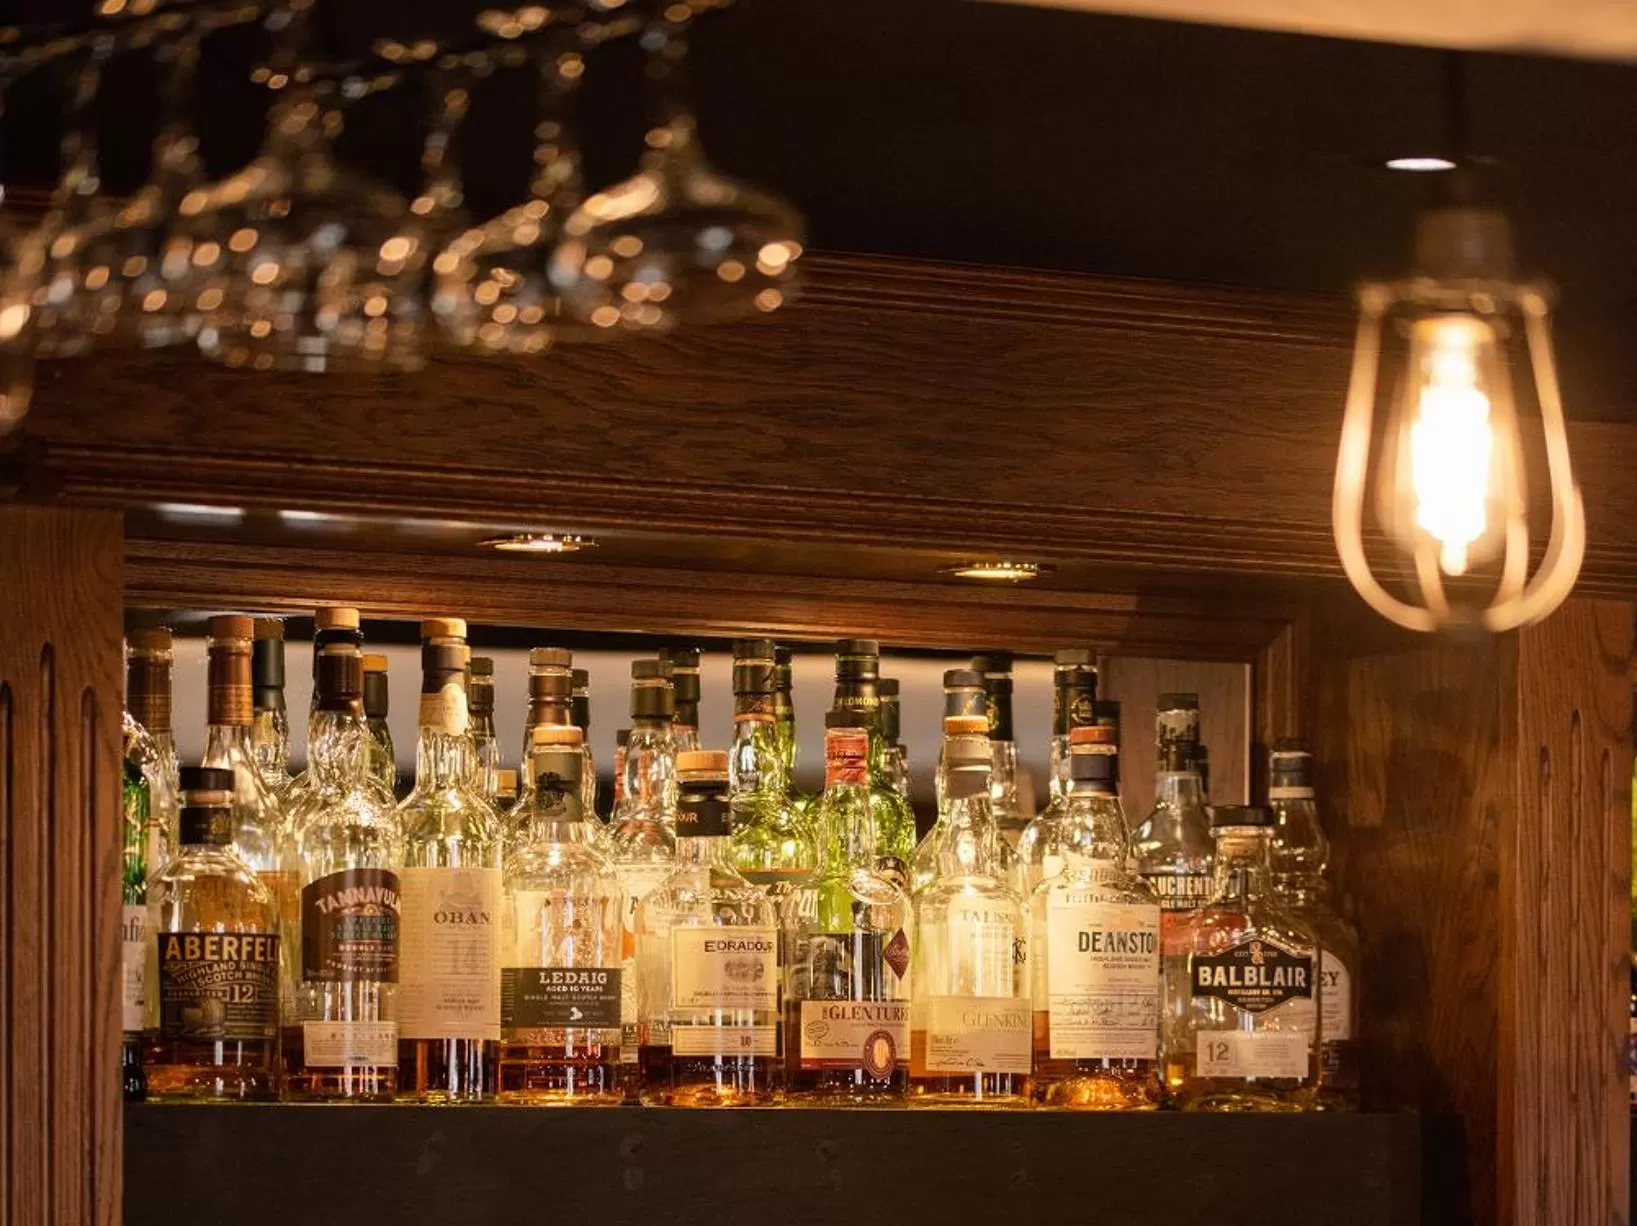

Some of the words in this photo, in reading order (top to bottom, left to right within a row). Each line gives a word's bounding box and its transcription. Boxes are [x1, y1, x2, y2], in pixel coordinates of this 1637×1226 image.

[433, 911, 493, 925] OBAN
[539, 972, 608, 985] LEDAIG
[1198, 966, 1307, 988] BALBLAIR
[232, 985, 255, 1003] 12
[1206, 1042, 1230, 1062] 12
